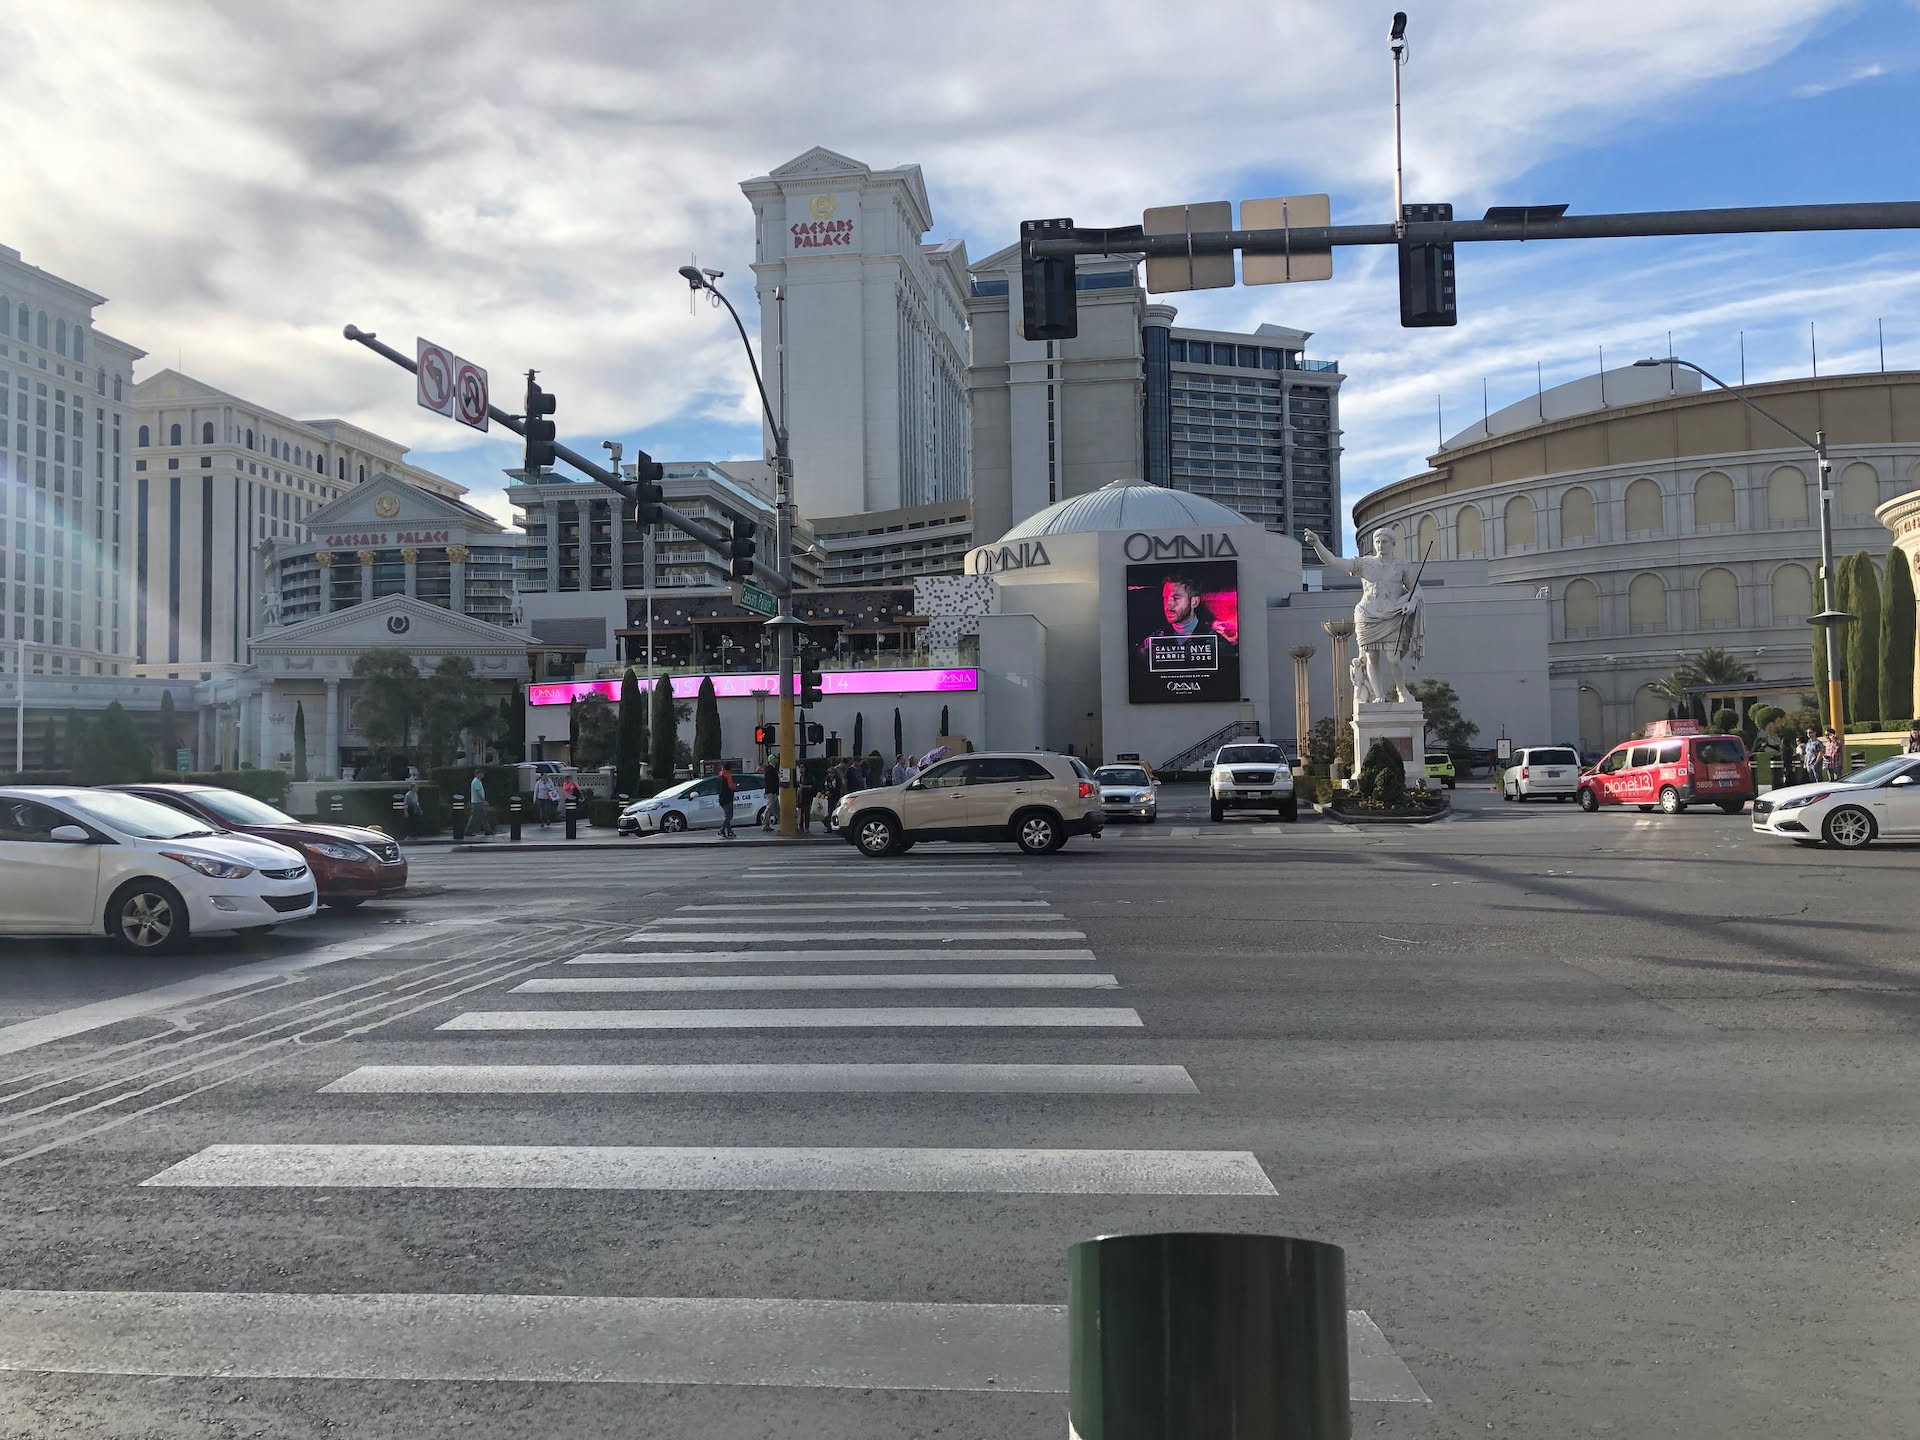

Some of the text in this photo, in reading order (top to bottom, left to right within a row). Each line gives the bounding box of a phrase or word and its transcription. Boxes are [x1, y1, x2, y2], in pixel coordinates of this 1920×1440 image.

[791, 219, 854, 235] CAESARS
[794, 232, 850, 248] PALACE
[326, 530, 449, 547] CAESARS PALACE
[1123, 532, 1239, 562] OMNIA
[975, 541, 1051, 575] OMNIA
[1190, 644, 1211, 653] NYE
[825, 675, 849, 689] 14
[935, 672, 972, 684] OMNIA
[1166, 681, 1201, 691] OMNIA
[1604, 777, 1638, 798] planet
